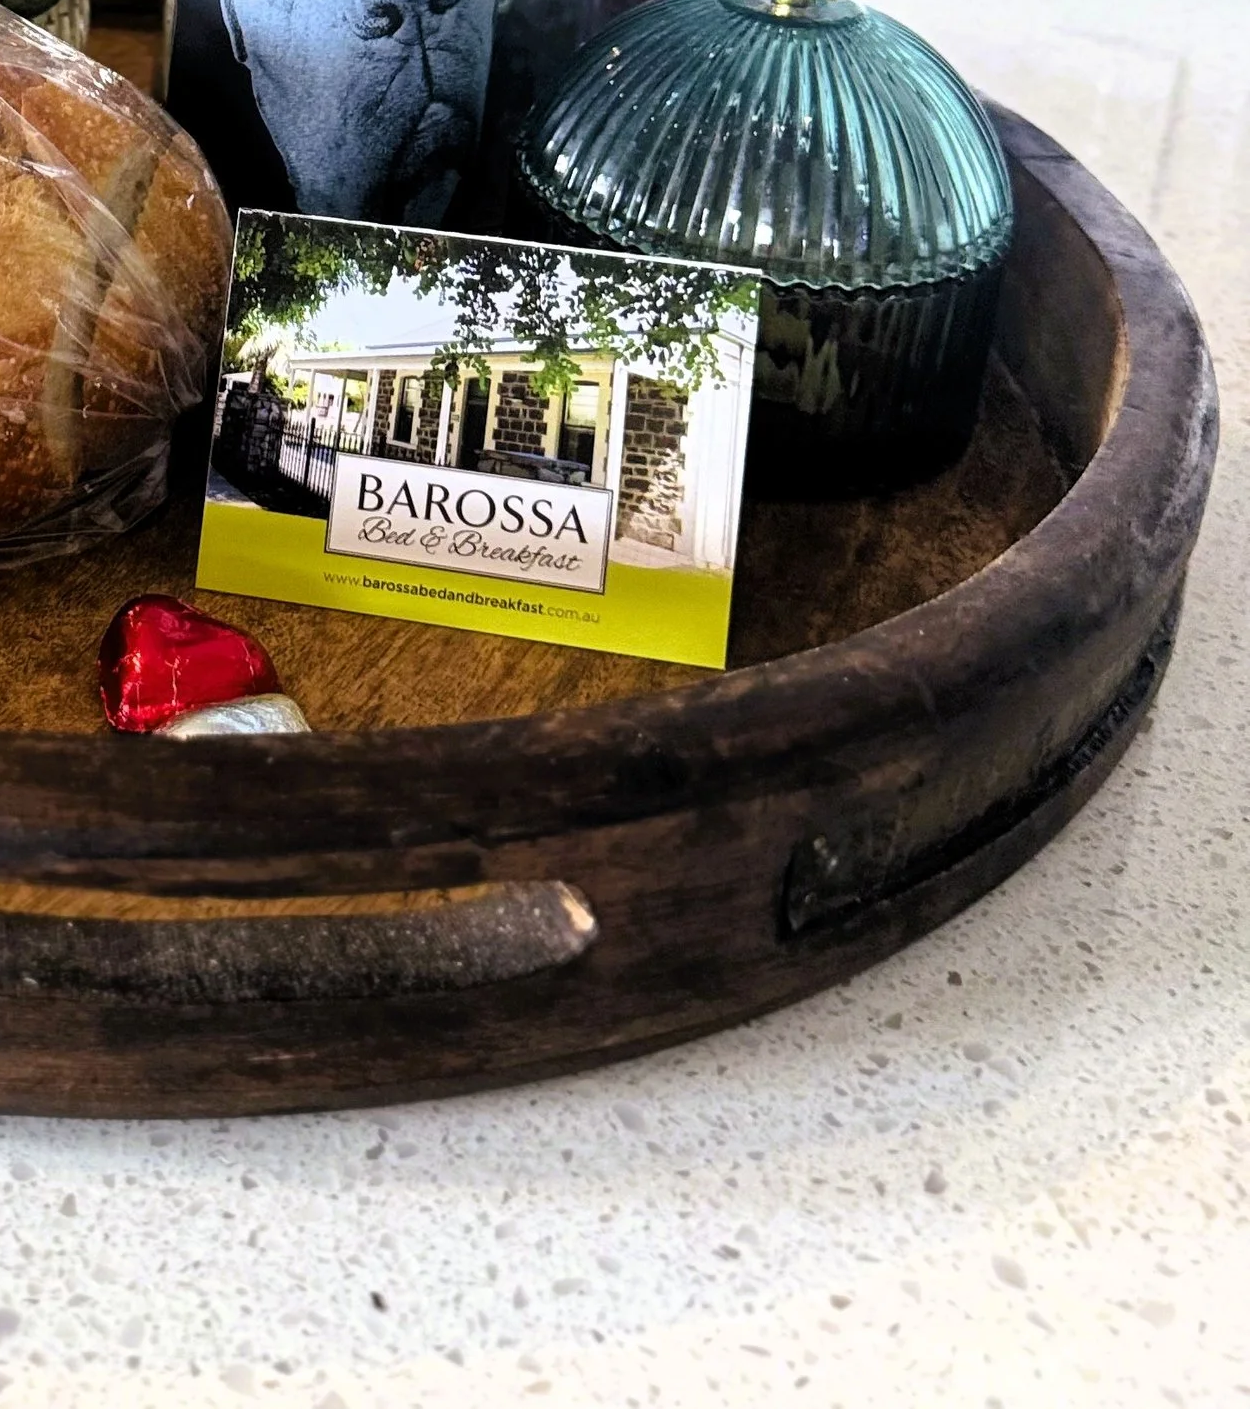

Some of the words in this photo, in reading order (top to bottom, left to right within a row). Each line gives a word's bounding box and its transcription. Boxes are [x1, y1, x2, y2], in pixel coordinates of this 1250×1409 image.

[357, 473, 589, 544] BAROSSA
[358, 516, 416, 546] Bed
[420, 526, 447, 555] &
[448, 529, 584, 571] Breakfast
[323, 571, 601, 624] www.barossabedandbreakfast.com.au
